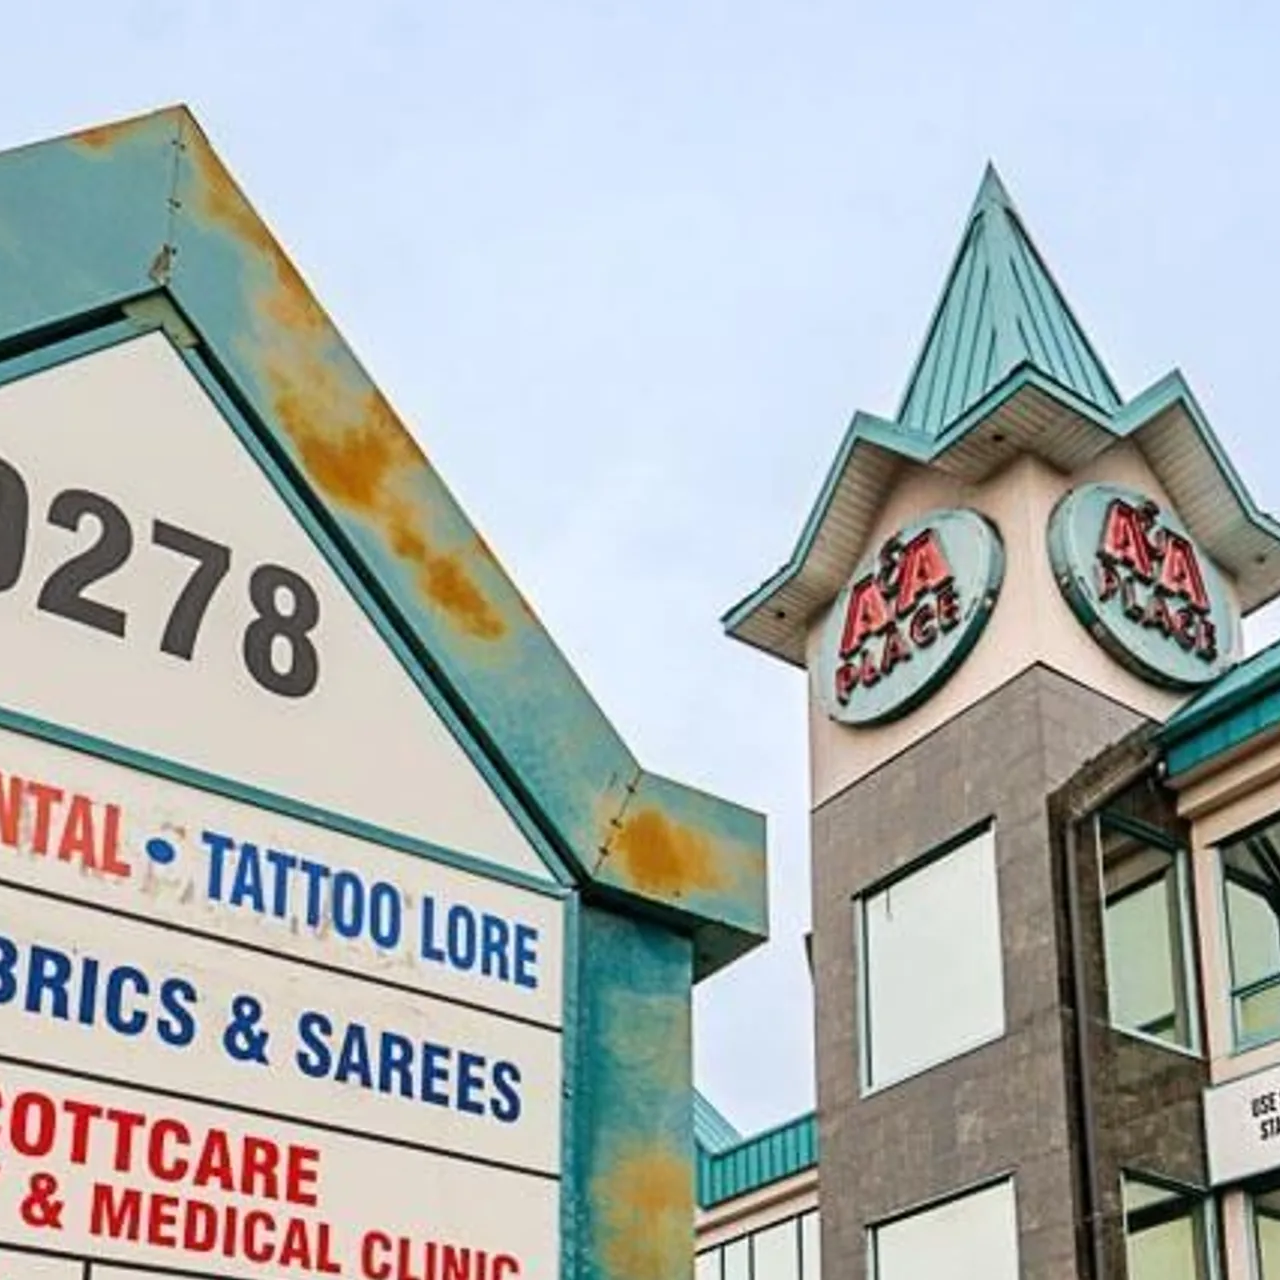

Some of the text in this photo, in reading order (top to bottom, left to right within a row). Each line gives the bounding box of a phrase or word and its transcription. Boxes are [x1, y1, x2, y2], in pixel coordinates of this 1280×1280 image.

[834, 588, 961, 706] PLACE
[1097, 560, 1218, 663] PLACE
[201, 829, 402, 950] TATTOO
[421, 895, 540, 990] LORE
[222, 997, 269, 1064] &
[295, 1014, 522, 1124] SAREES
[1251, 1092, 1276, 1117] USE
[22, 1172, 65, 1232] &
[87, 1179, 344, 1277] MEDICAL
